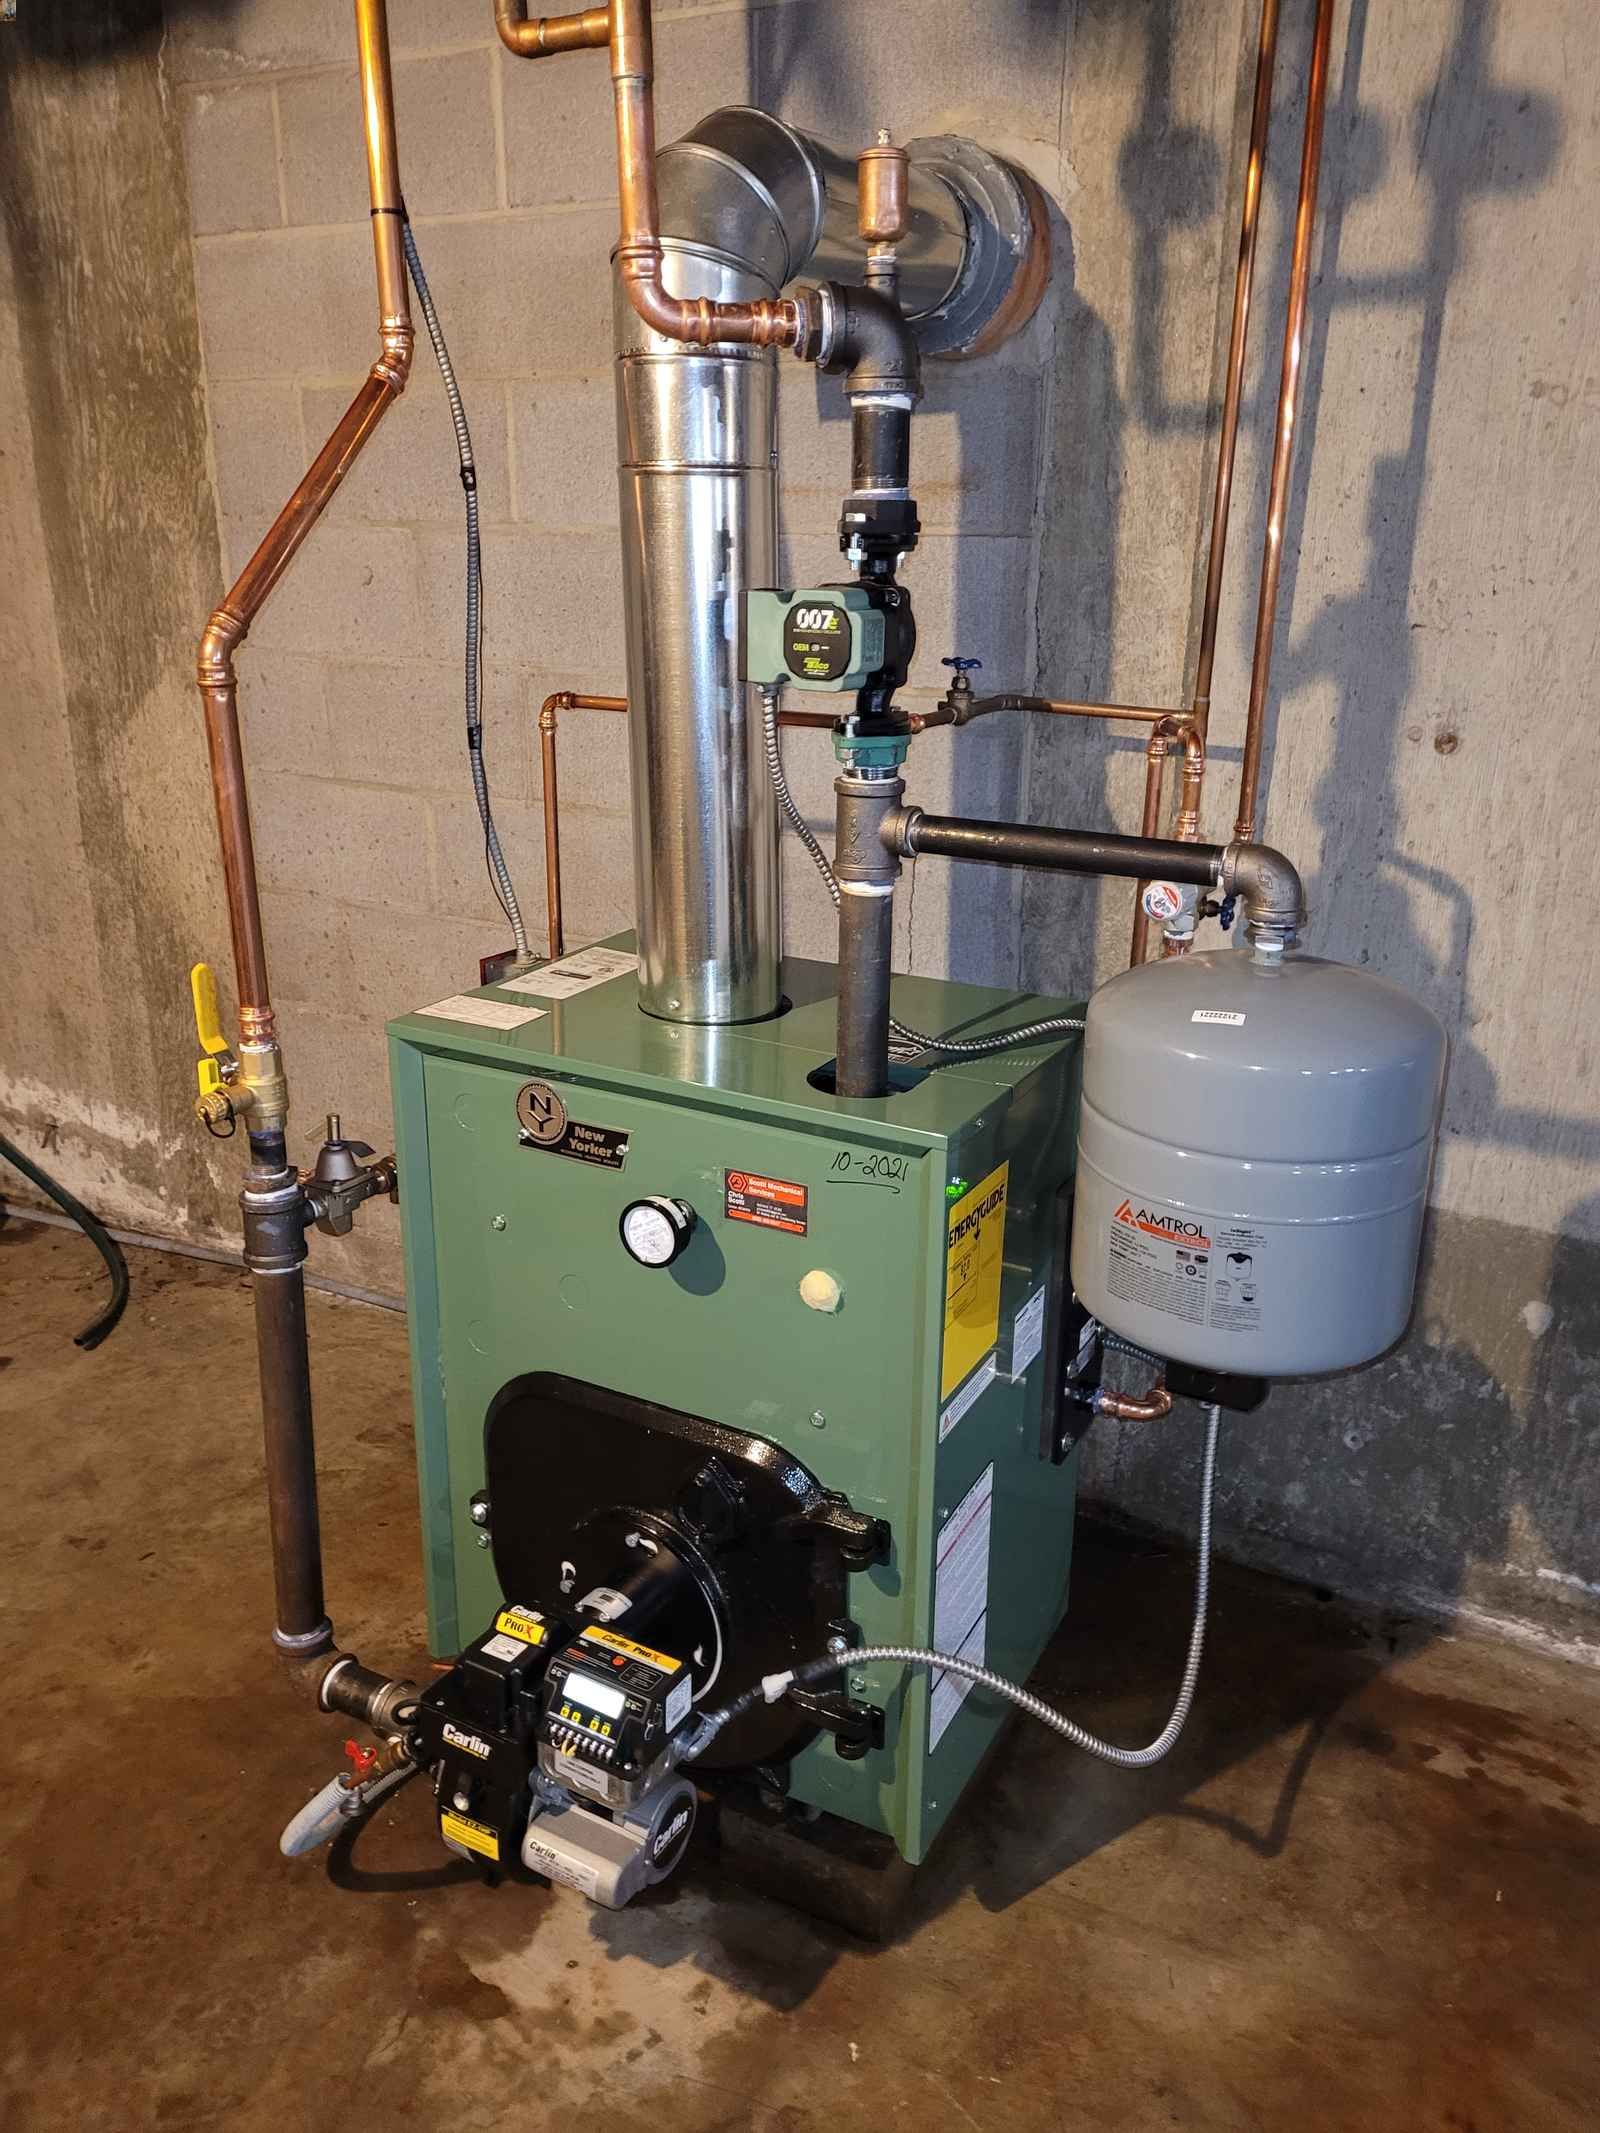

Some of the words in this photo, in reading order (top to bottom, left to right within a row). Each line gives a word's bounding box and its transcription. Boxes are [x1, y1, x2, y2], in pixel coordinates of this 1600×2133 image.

[569, 1138, 613, 1158] Yorker
[574, 1126, 605, 1142] New
[830, 1150, 909, 1182] 10-2021
[1136, 1208, 1207, 1239] AMTROL
[442, 1722, 492, 1758] Carlin
[653, 1810, 689, 1856] Carlin
[529, 1840, 556, 1860] Carlin
